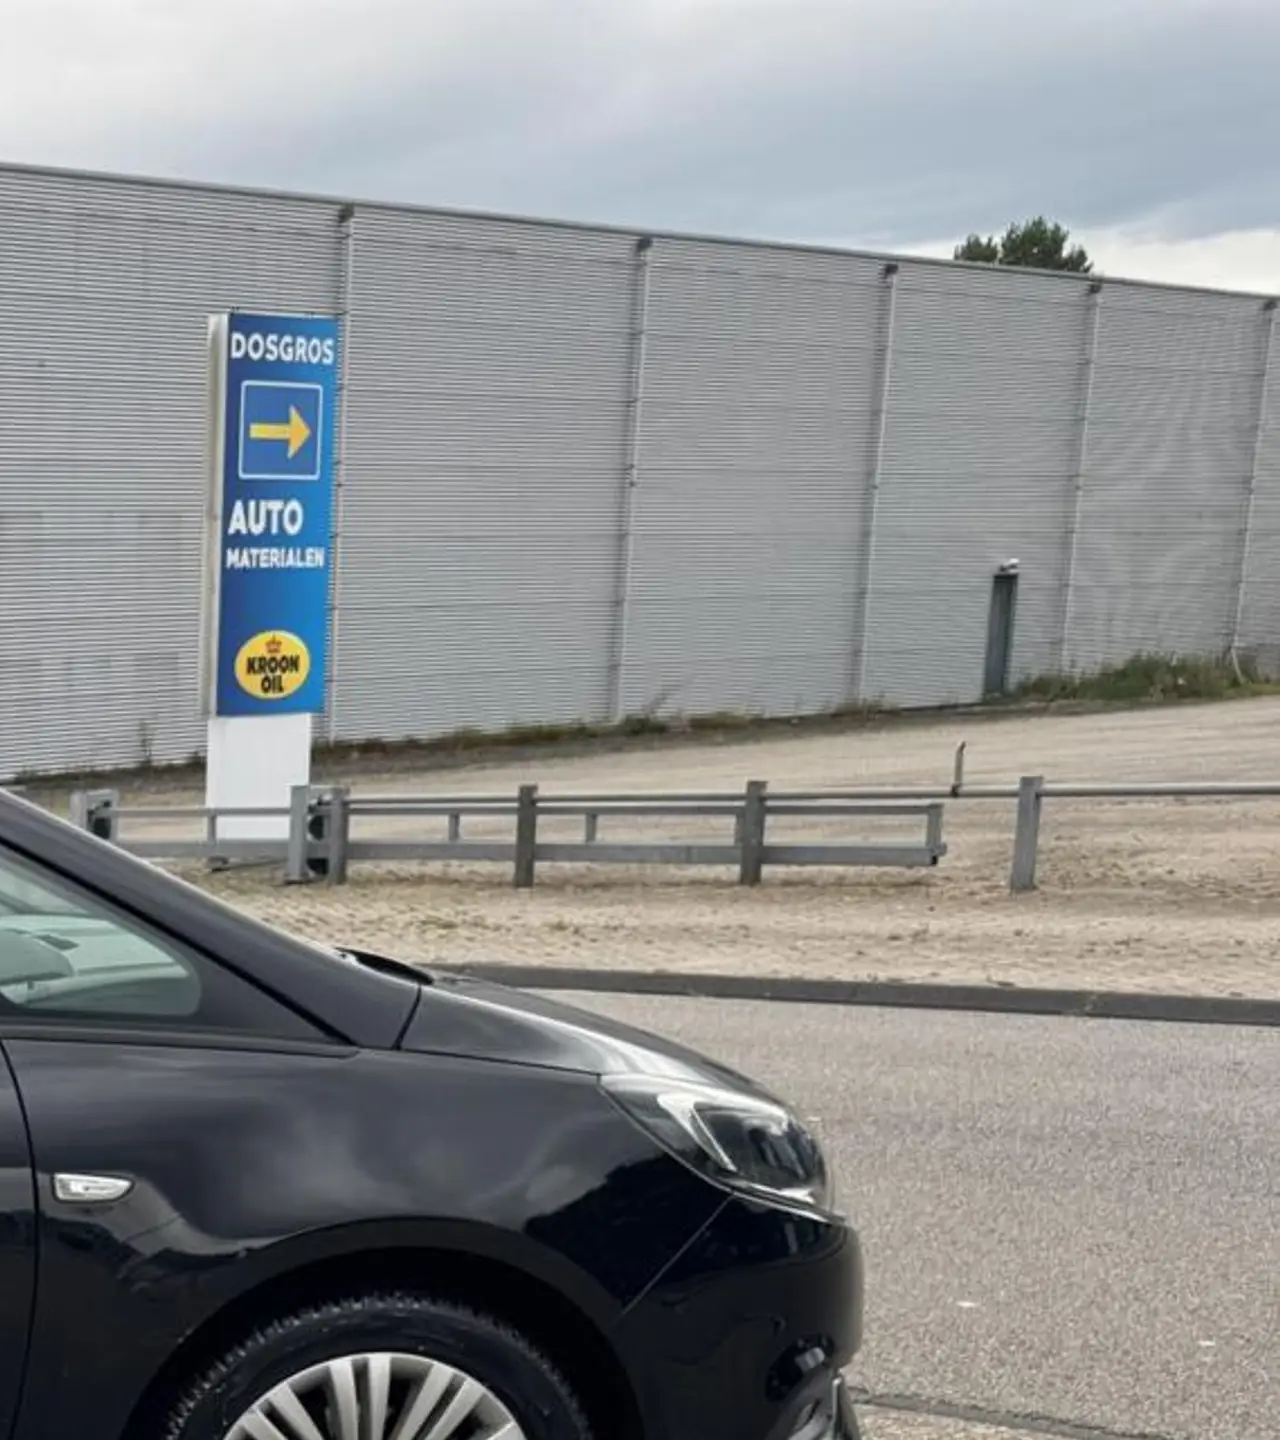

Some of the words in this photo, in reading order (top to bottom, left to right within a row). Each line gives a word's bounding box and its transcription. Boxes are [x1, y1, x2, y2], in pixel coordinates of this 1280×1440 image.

[230, 331, 334, 365] DOSGROS
[228, 499, 304, 536] AUTO
[225, 547, 325, 568] MATERIALEN
[247, 655, 299, 674] KROON
[261, 675, 284, 693] OIL
